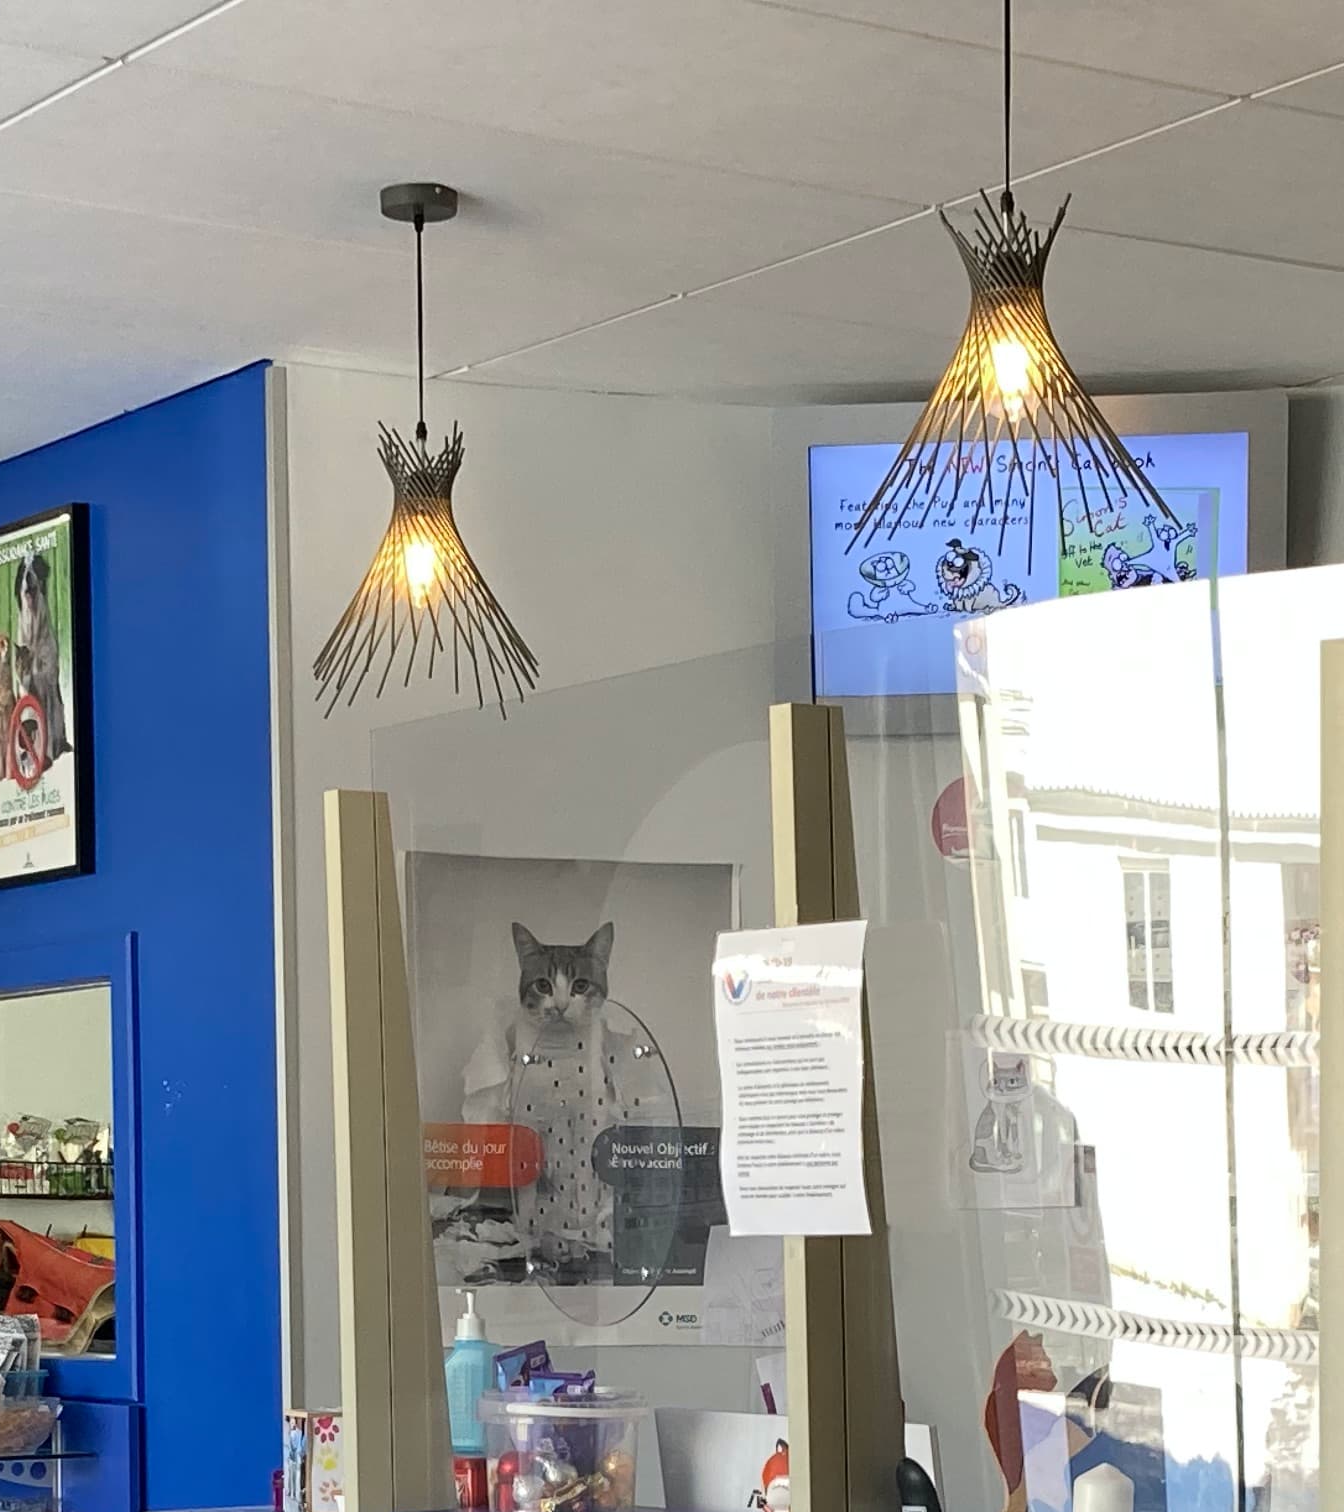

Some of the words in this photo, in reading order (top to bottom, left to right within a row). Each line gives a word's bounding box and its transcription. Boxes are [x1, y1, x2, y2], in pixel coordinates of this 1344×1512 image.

[840, 499, 898, 516] Featring
[463, 1140, 478, 1153] du
[612, 1142, 653, 1155] Nouvel
